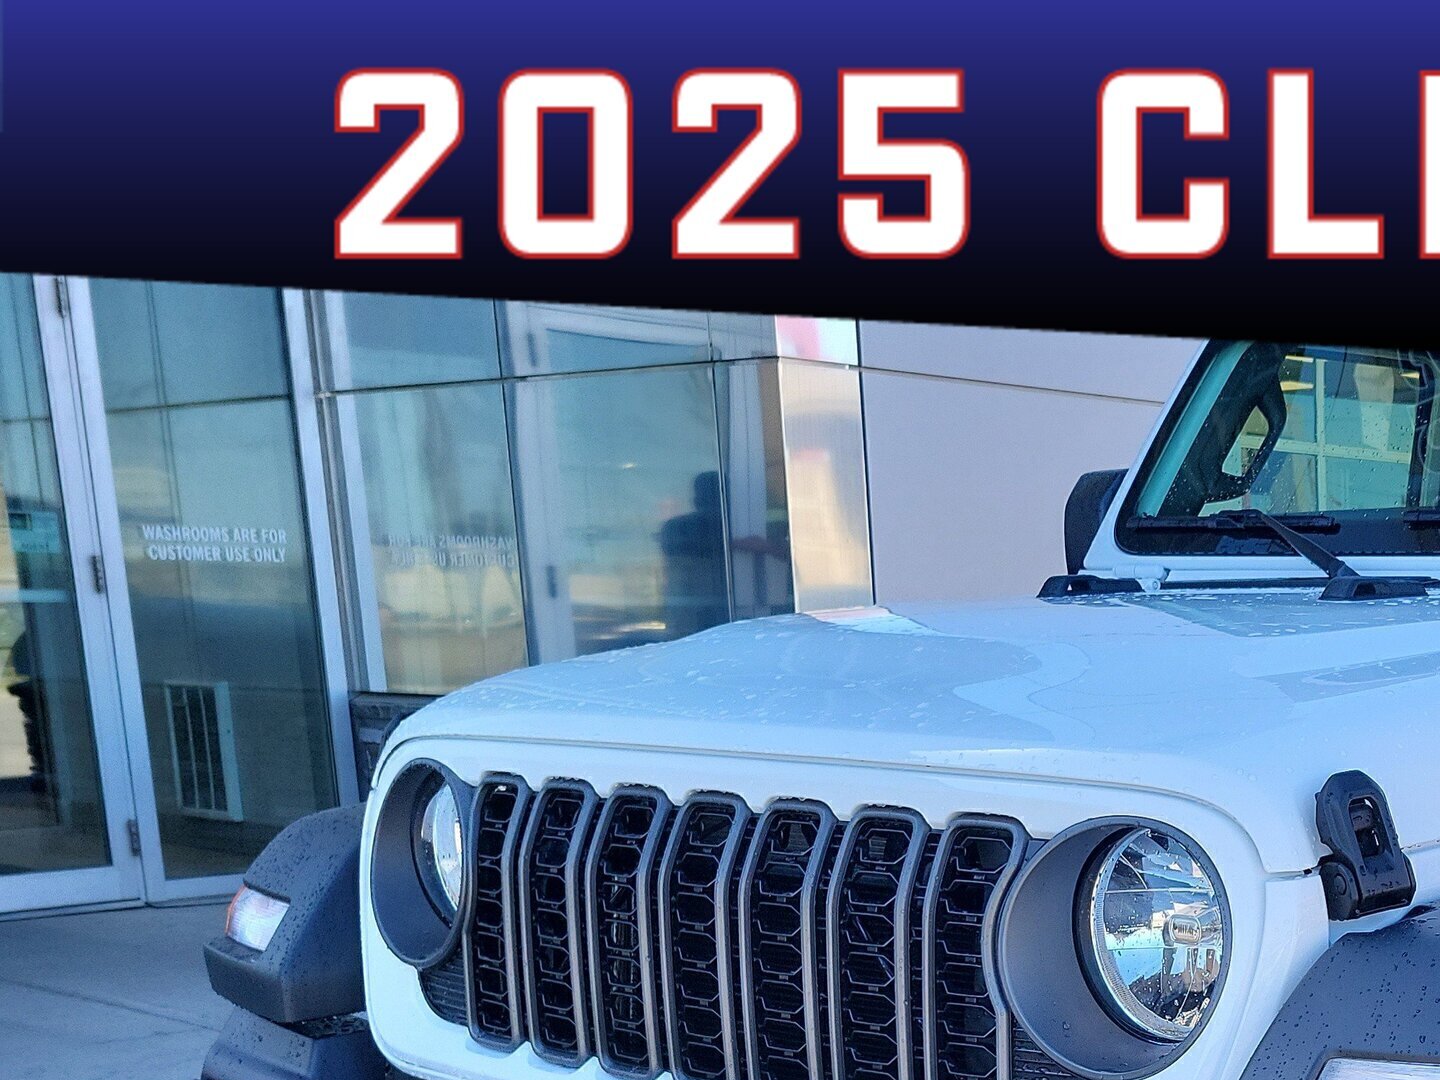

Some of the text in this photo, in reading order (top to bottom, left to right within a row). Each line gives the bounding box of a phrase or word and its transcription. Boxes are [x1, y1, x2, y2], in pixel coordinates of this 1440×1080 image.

[142, 524, 287, 544] WASHROOMS ARE FOR
[149, 544, 286, 563] CUSTOMER USE ONLY
